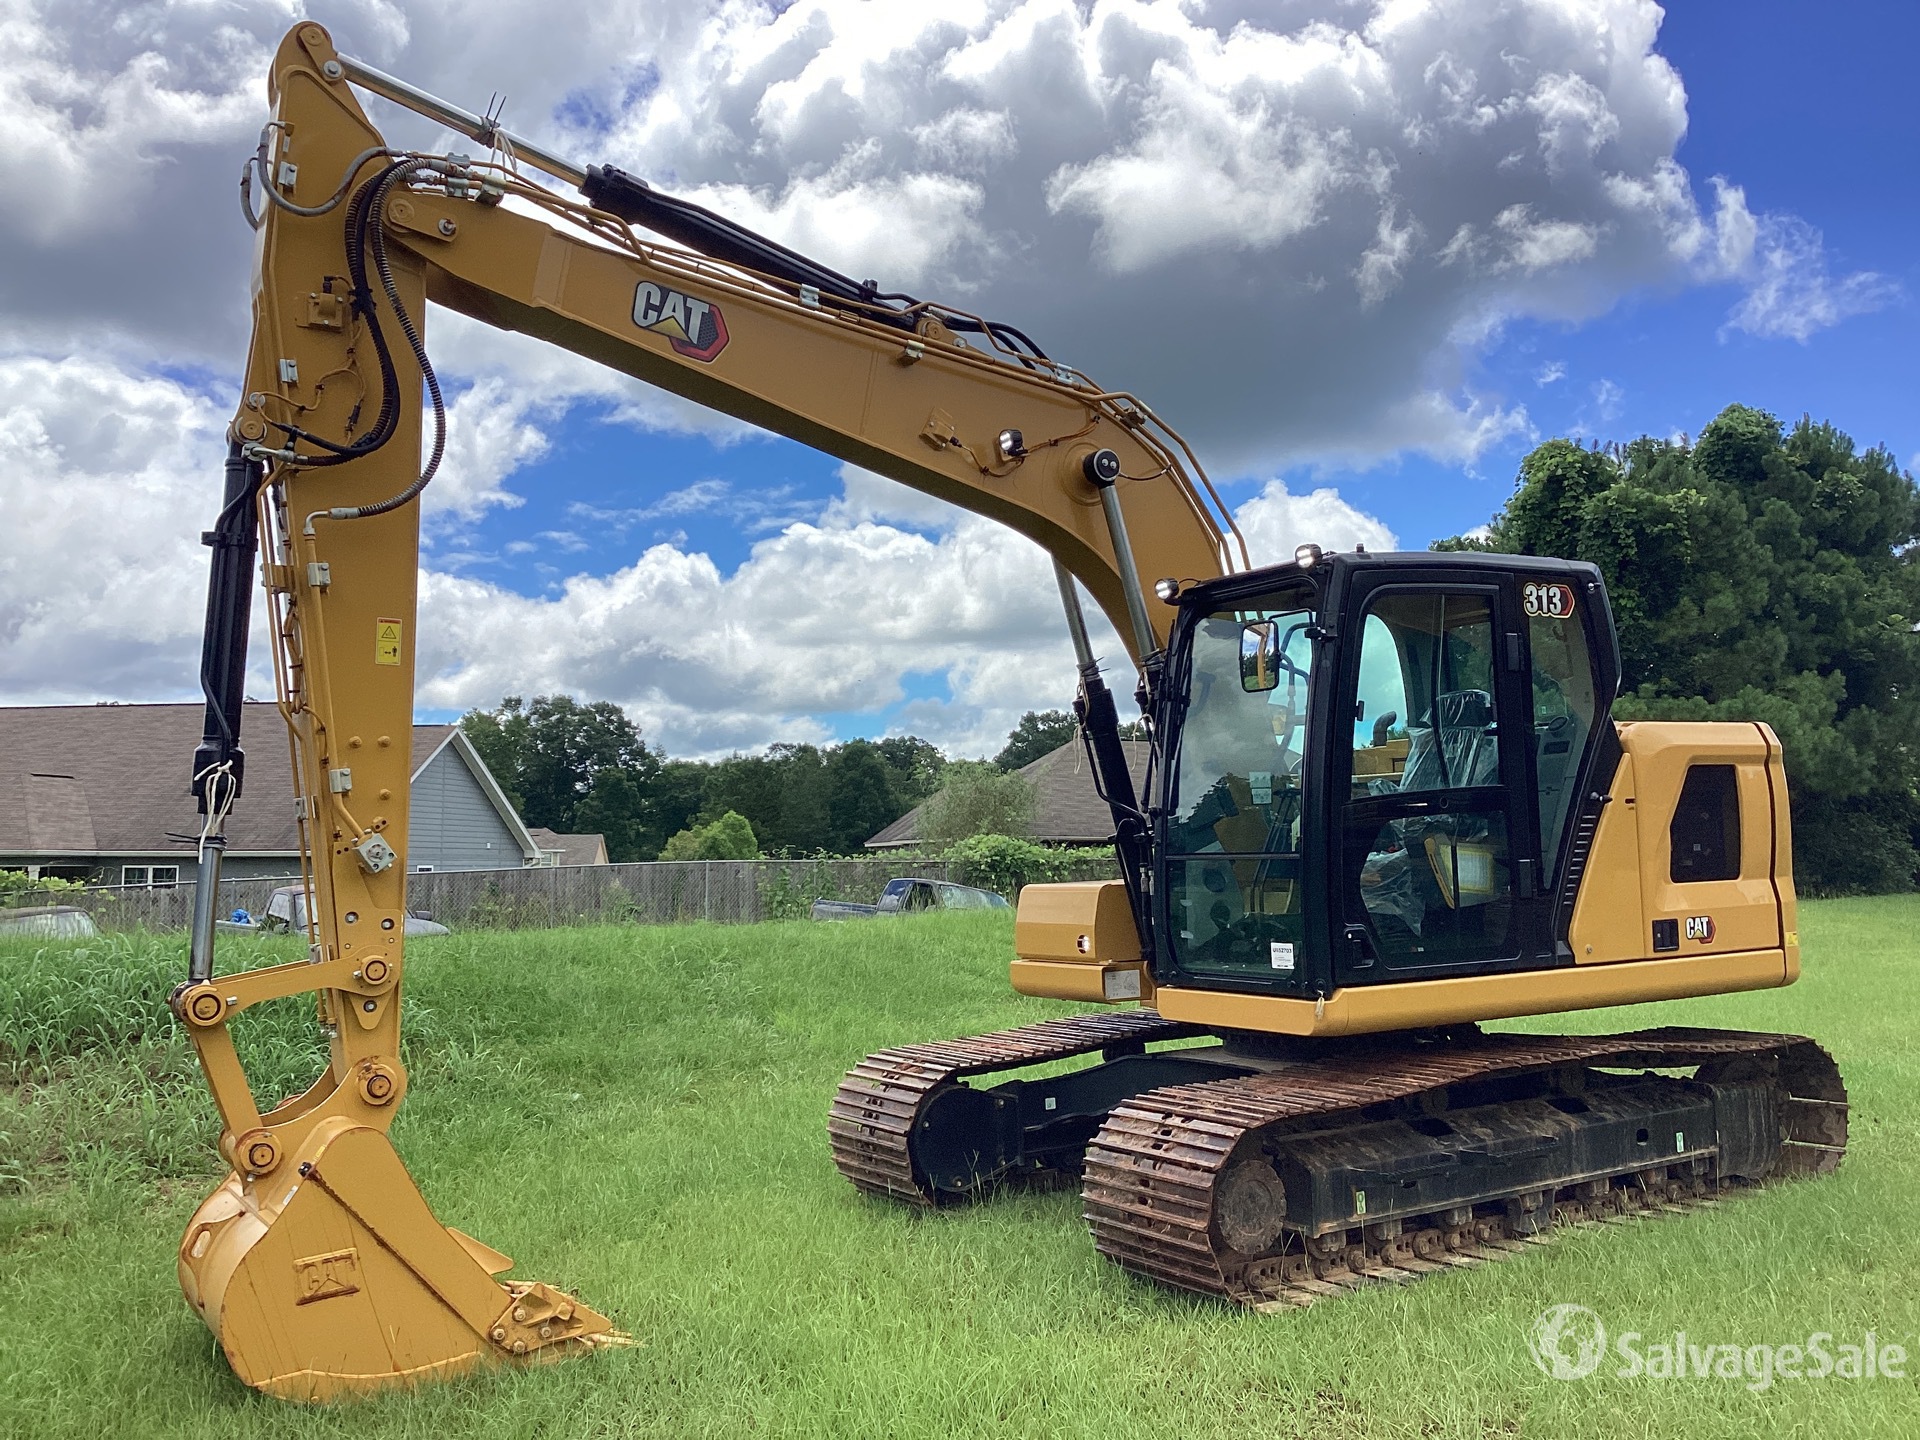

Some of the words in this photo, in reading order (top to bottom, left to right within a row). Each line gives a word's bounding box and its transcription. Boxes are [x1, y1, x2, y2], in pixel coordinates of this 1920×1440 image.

[633, 282, 710, 345] CAT
[1525, 585, 1562, 614] 313
[1686, 917, 1709, 939] CAT
[298, 1254, 357, 1299] CAT
